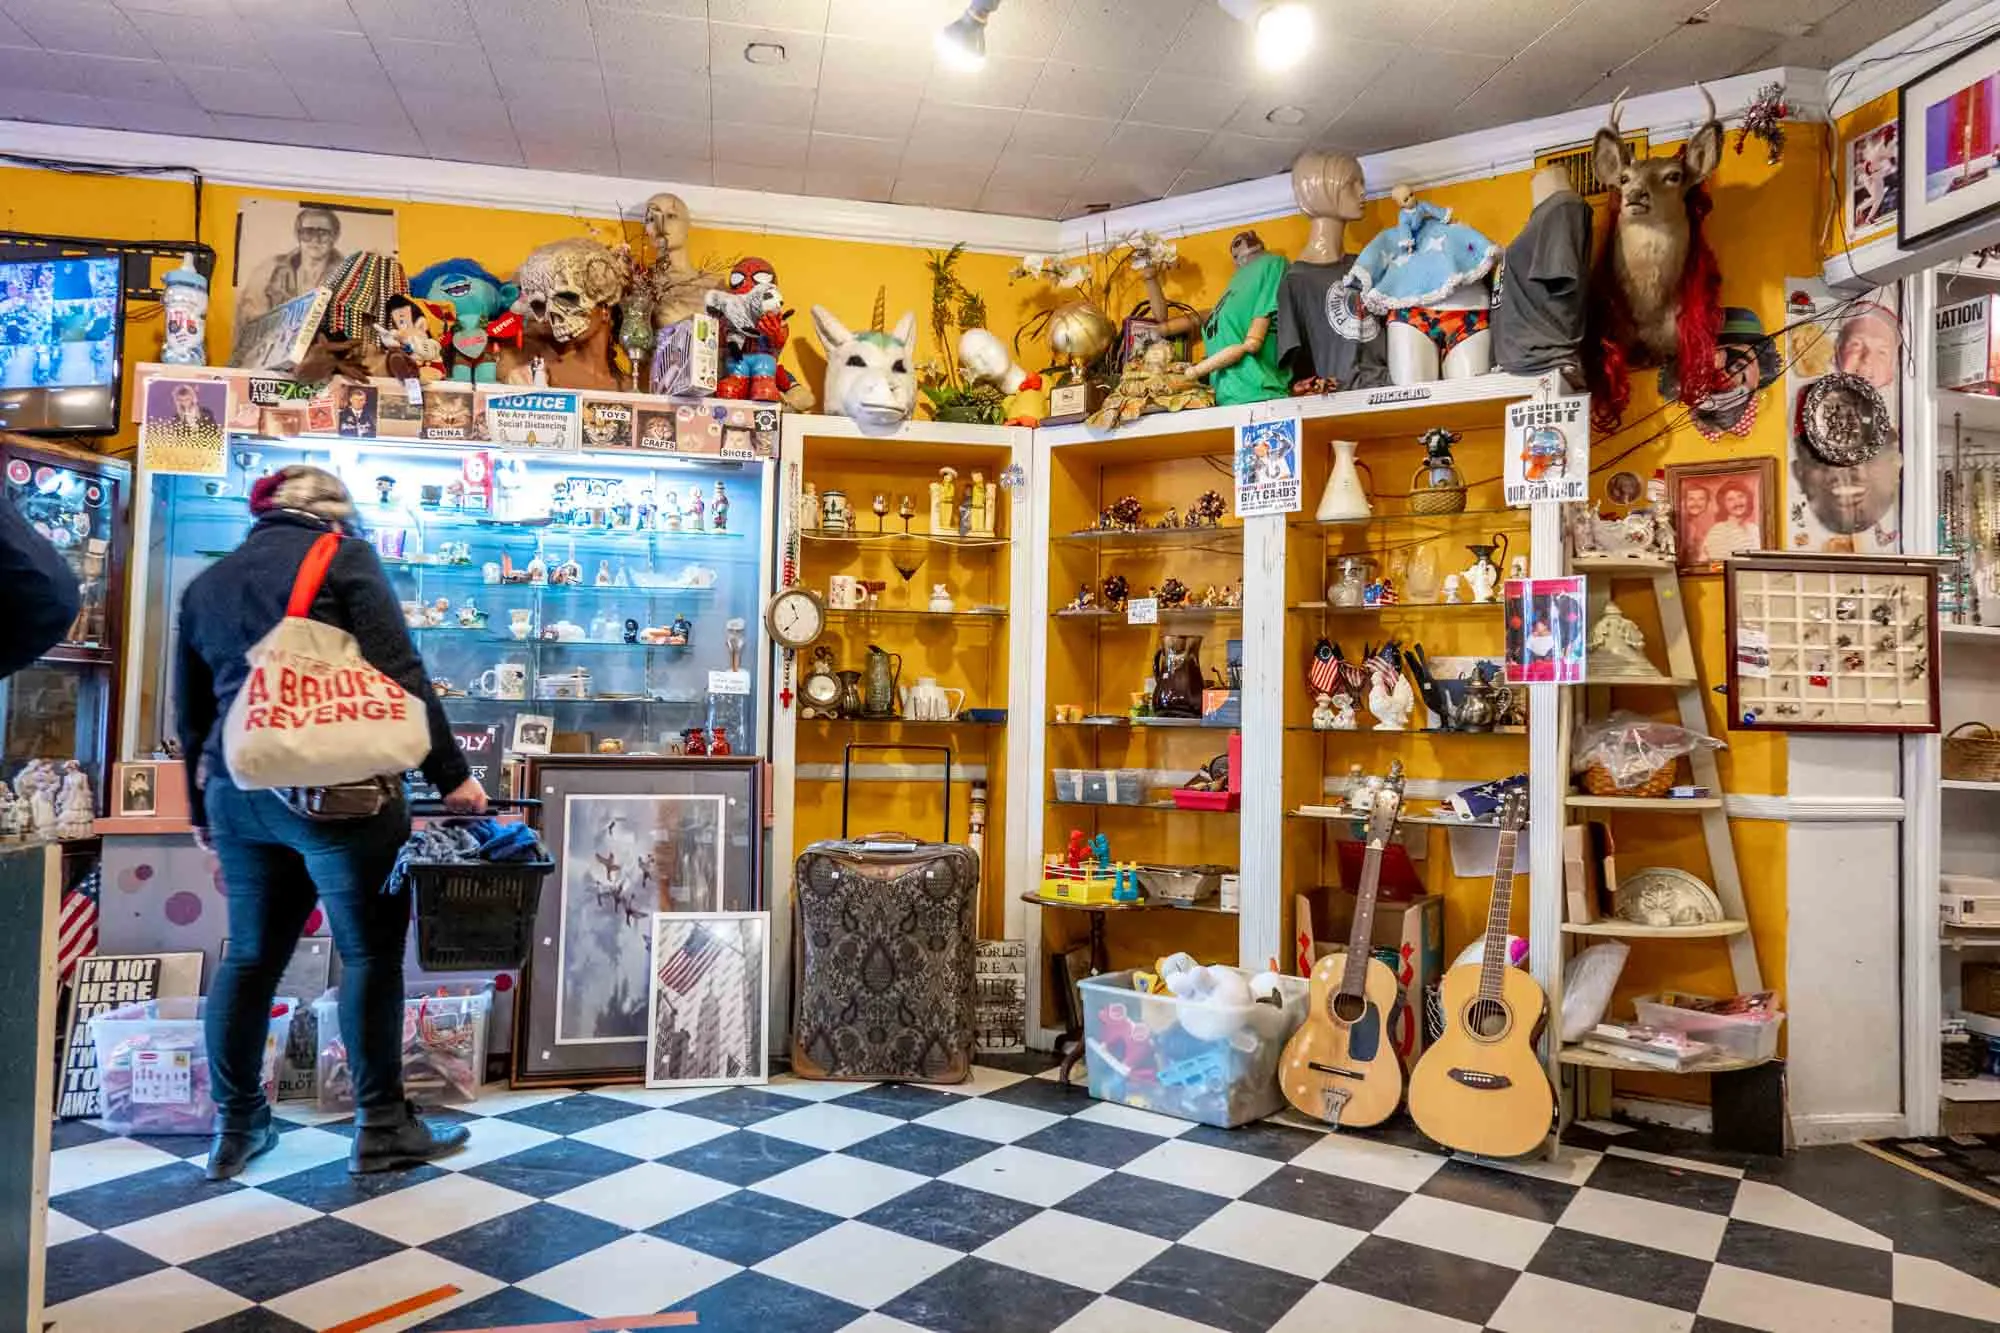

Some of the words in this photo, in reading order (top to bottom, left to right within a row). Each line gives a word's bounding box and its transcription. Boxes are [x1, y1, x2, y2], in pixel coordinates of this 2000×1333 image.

[251, 379, 276, 394] YOU
[498, 394, 567, 410] NOTICE
[1527, 402, 1561, 413] SURE
[1564, 401, 1581, 409] TO
[497, 410, 510, 418] We
[512, 411, 527, 419] Are
[528, 412, 568, 421] Practicing
[601, 410, 627, 419] TOYS
[1512, 408, 1580, 428] VISIT
[497, 420, 523, 429] Social
[525, 421, 567, 431] Distancing
[643, 439, 675, 449] CRAFTS
[722, 449, 753, 458] SHOES
[1241, 490, 1260, 502] GIFT
[1263, 486, 1297, 500] CARDS
[1508, 484, 1526, 503] OUR
[248, 666, 269, 706] A
[244, 701, 407, 731] REVENGE
[82, 960, 113, 982] I'M
[116, 959, 156, 981] NOT
[79, 981, 153, 1003] HERE
